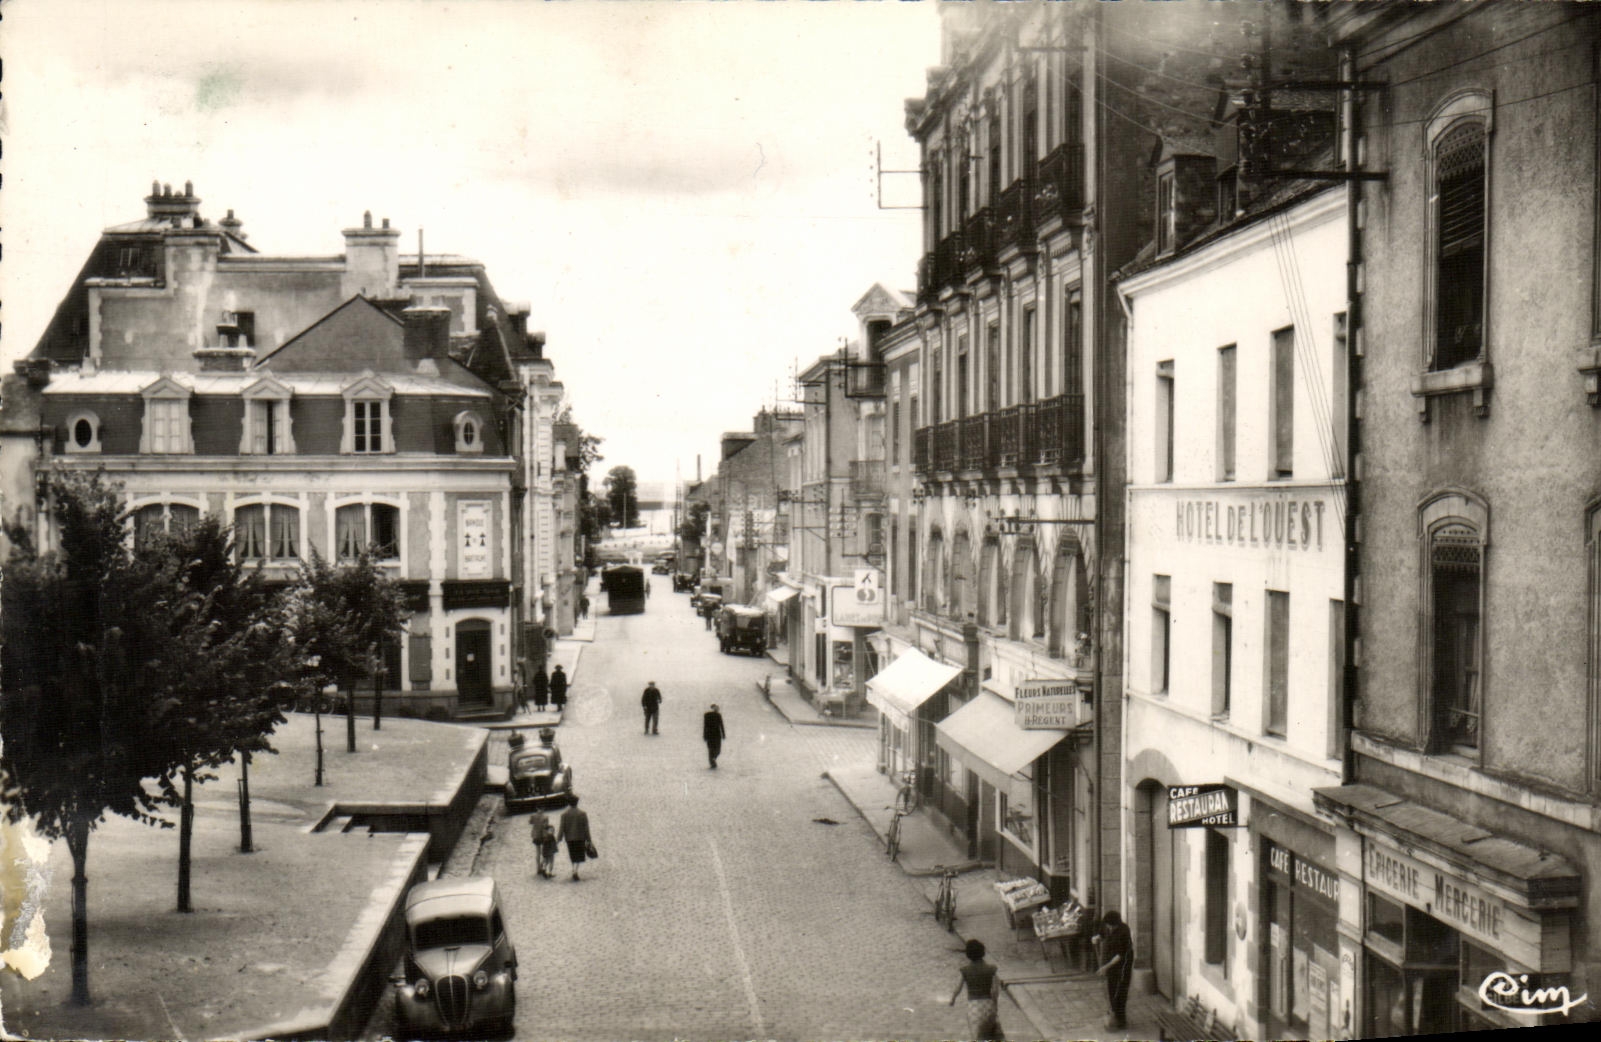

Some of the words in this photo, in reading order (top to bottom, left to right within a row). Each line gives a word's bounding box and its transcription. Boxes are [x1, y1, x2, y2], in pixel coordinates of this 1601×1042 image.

[1176, 500, 1222, 543] HOTEL
[1227, 504, 1246, 546] DE
[1201, 812, 1235, 825] HOTEL
[1434, 873, 1502, 941] MERCERIE
